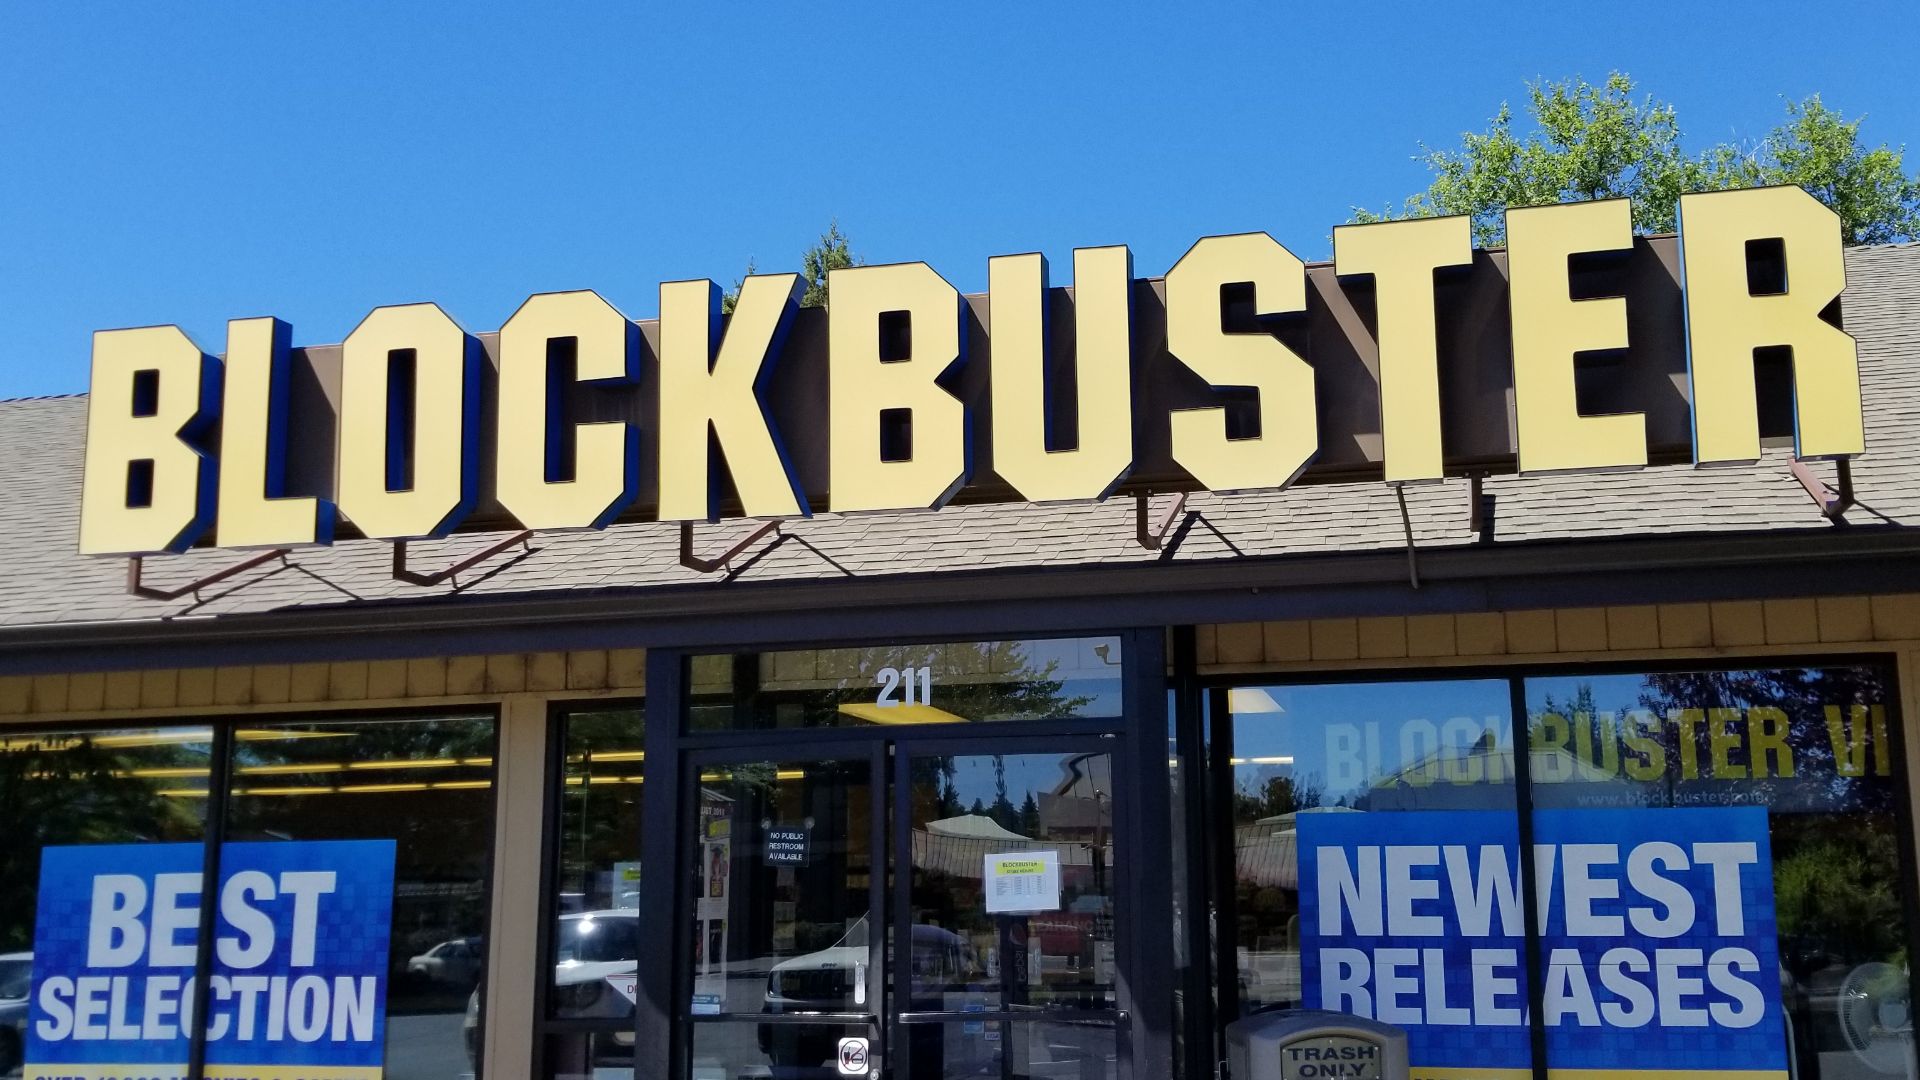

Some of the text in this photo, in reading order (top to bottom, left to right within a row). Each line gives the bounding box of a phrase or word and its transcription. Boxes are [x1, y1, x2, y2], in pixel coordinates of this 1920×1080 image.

[78, 184, 1866, 556] BLOCKBUSTER
[876, 667, 932, 707] 211
[1324, 706, 1796, 790] BLOCKBUSTER
[768, 842, 804, 850] RESTROOM
[768, 852, 803, 861] AVAILABLE
[770, 832, 804, 840] NO PUBLIC
[1316, 841, 1758, 938] NEWEST
[87, 870, 337, 969] BEST
[36, 976, 376, 1042] SELECTION
[1320, 948, 1764, 1028] RELEASES
[1287, 1046, 1375, 1061] TRASH
[1299, 1064, 1367, 1078] ONLY
